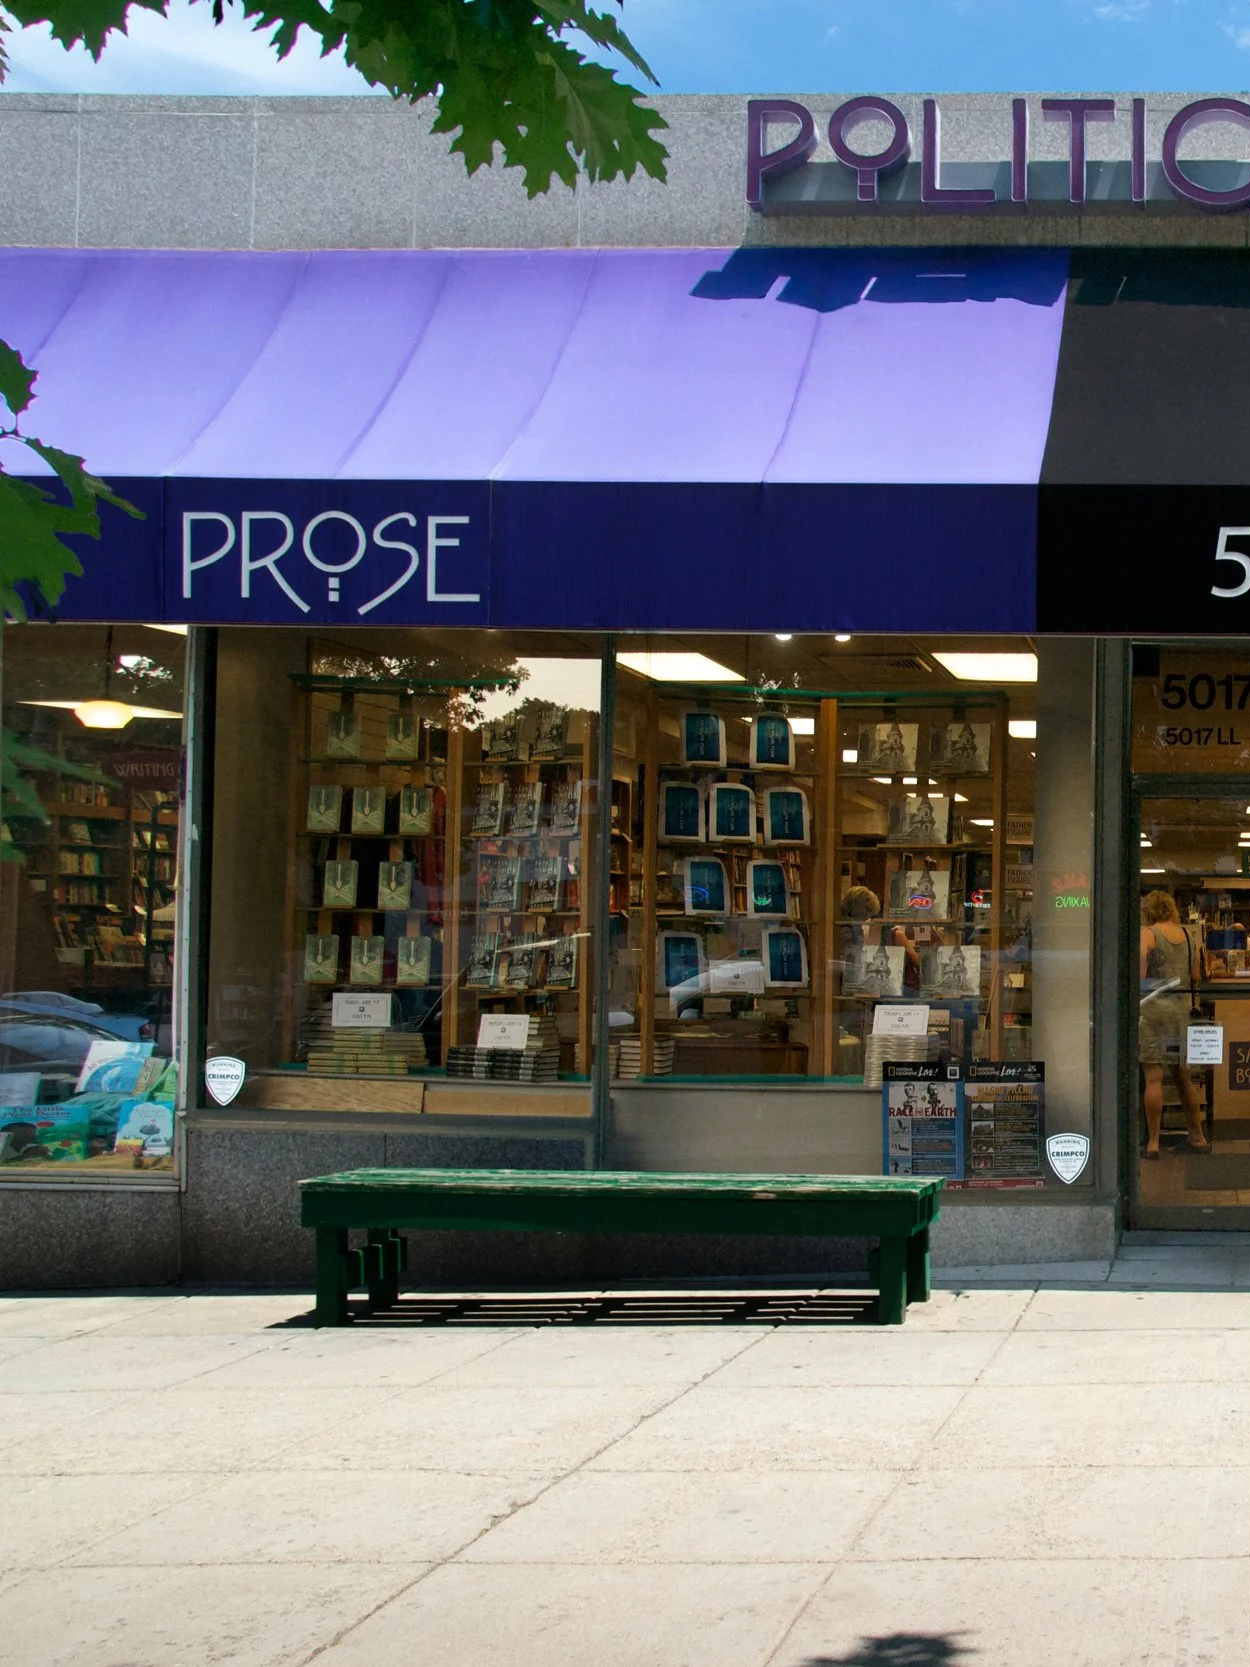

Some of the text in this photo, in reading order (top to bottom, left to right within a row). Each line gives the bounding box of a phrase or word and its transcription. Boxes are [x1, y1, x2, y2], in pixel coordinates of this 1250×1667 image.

[182, 510, 481, 615] PROSE
[1164, 726, 1214, 746] 5017
[113, 762, 175, 777] WRITING
[888, 1107, 957, 1117] RACE EARTH
